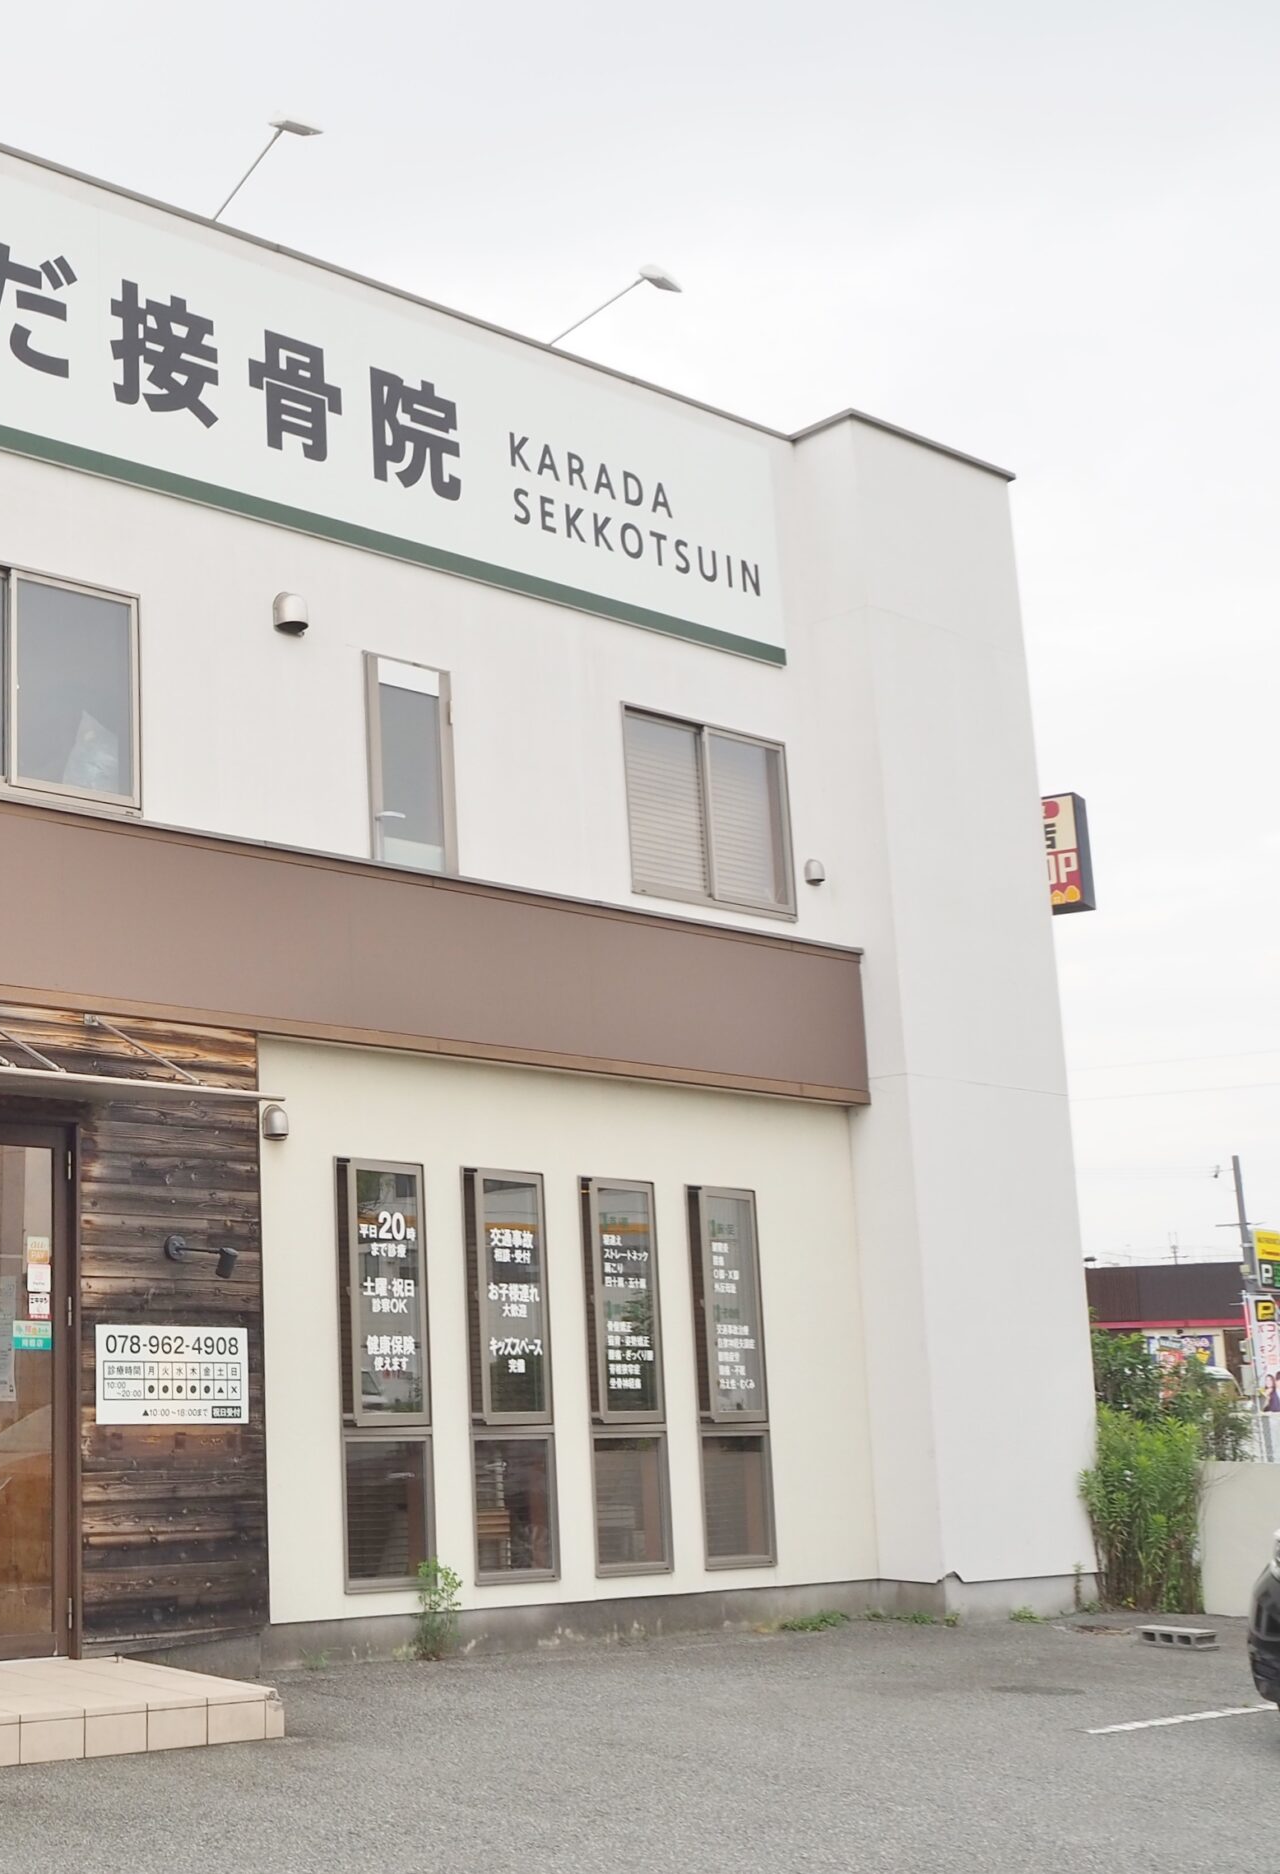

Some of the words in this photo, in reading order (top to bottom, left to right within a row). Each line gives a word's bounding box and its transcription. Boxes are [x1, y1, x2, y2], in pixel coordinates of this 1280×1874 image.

[509, 431, 673, 518] KARADA
[513, 487, 761, 597] SEKKOTSUIN
[489, 1228, 534, 1249] 交通事故
[603, 1249, 649, 1262] ストレートネック
[488, 1282, 540, 1303] お子様連れ
[105, 1334, 239, 1356] 078-962-4908
[366, 1334, 416, 1356] 健康保険
[489, 1337, 543, 1356] キッズスペース
[107, 1365, 142, 1376] 診療時間
[147, 1366, 155, 1376] 月
[162, 1367, 170, 1376] 火
[176, 1367, 184, 1376] 水
[190, 1367, 198, 1376] 木
[203, 1366, 212, 1376] 金
[217, 1367, 225, 1376] 土
[231, 1367, 238, 1376] 日
[374, 1356, 410, 1371] 使えます
